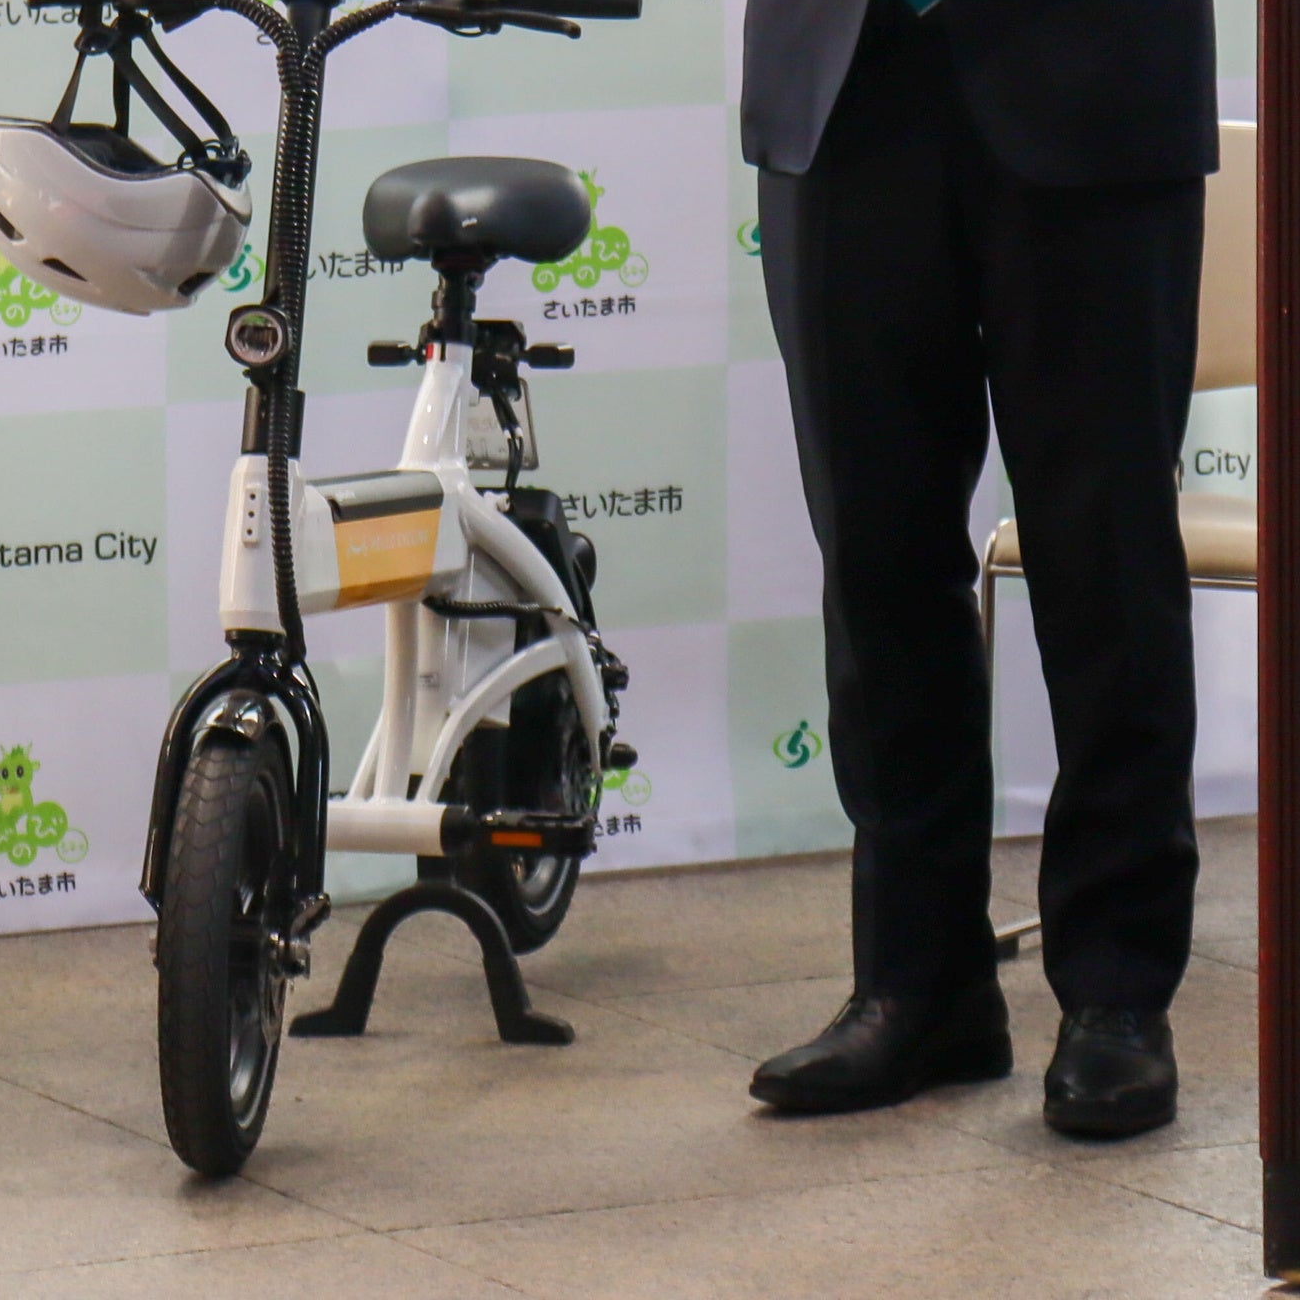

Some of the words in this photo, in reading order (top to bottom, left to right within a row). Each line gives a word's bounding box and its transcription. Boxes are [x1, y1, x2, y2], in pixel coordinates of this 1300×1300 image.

[543, 295, 636, 320] さいたま市
[1195, 448, 1251, 480] City
[96, 531, 158, 565] City
